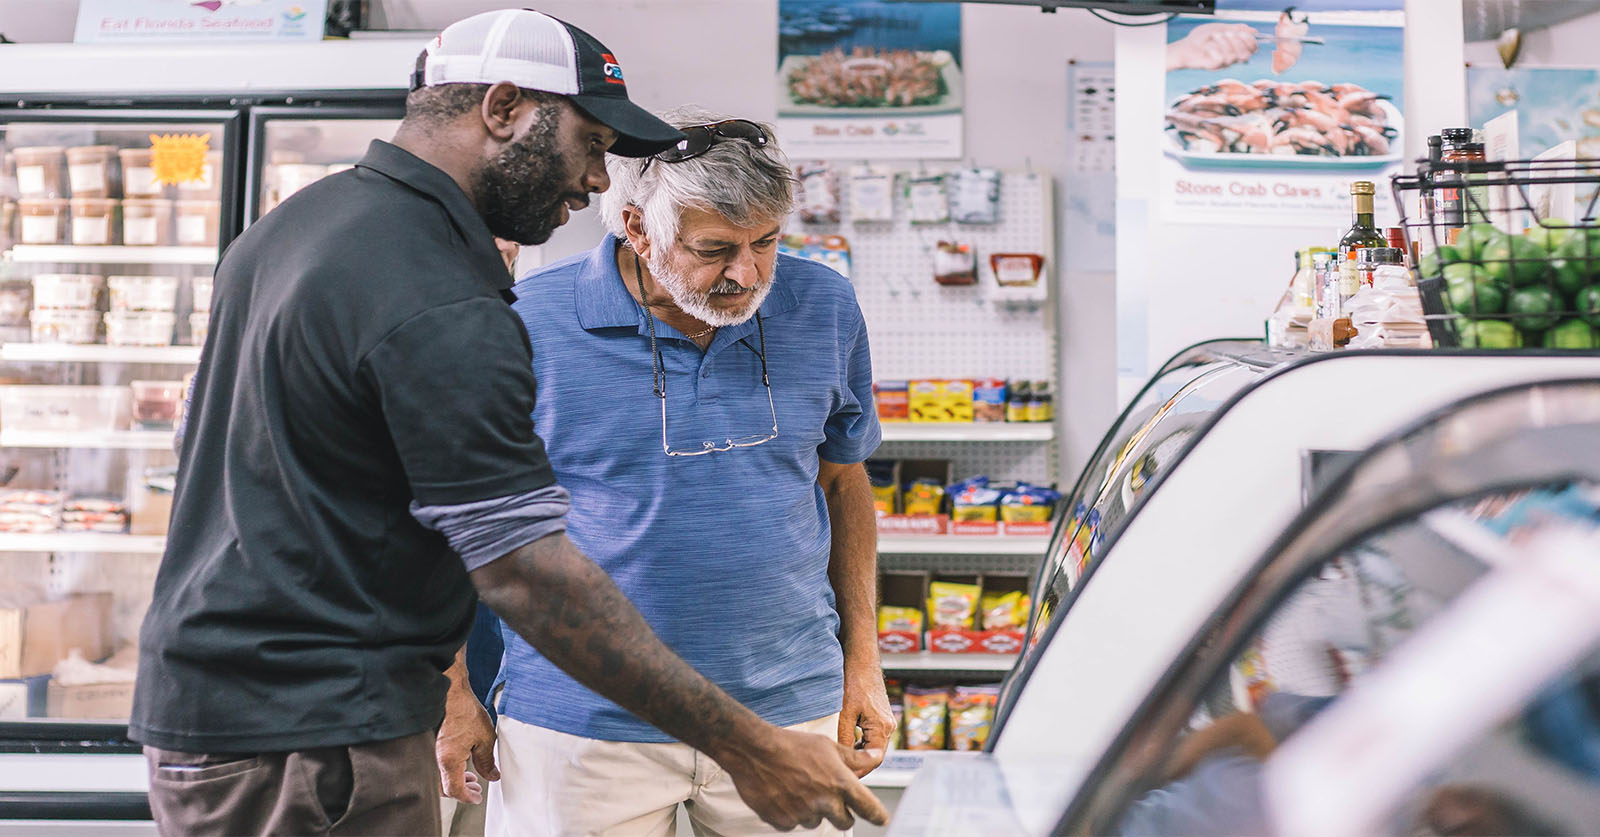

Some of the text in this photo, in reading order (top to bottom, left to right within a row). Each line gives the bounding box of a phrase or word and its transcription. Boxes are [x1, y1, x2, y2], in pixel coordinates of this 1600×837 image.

[1175, 180, 1222, 195] Stone
[1229, 181, 1267, 196] Crab
[1273, 182, 1322, 198] Claws
